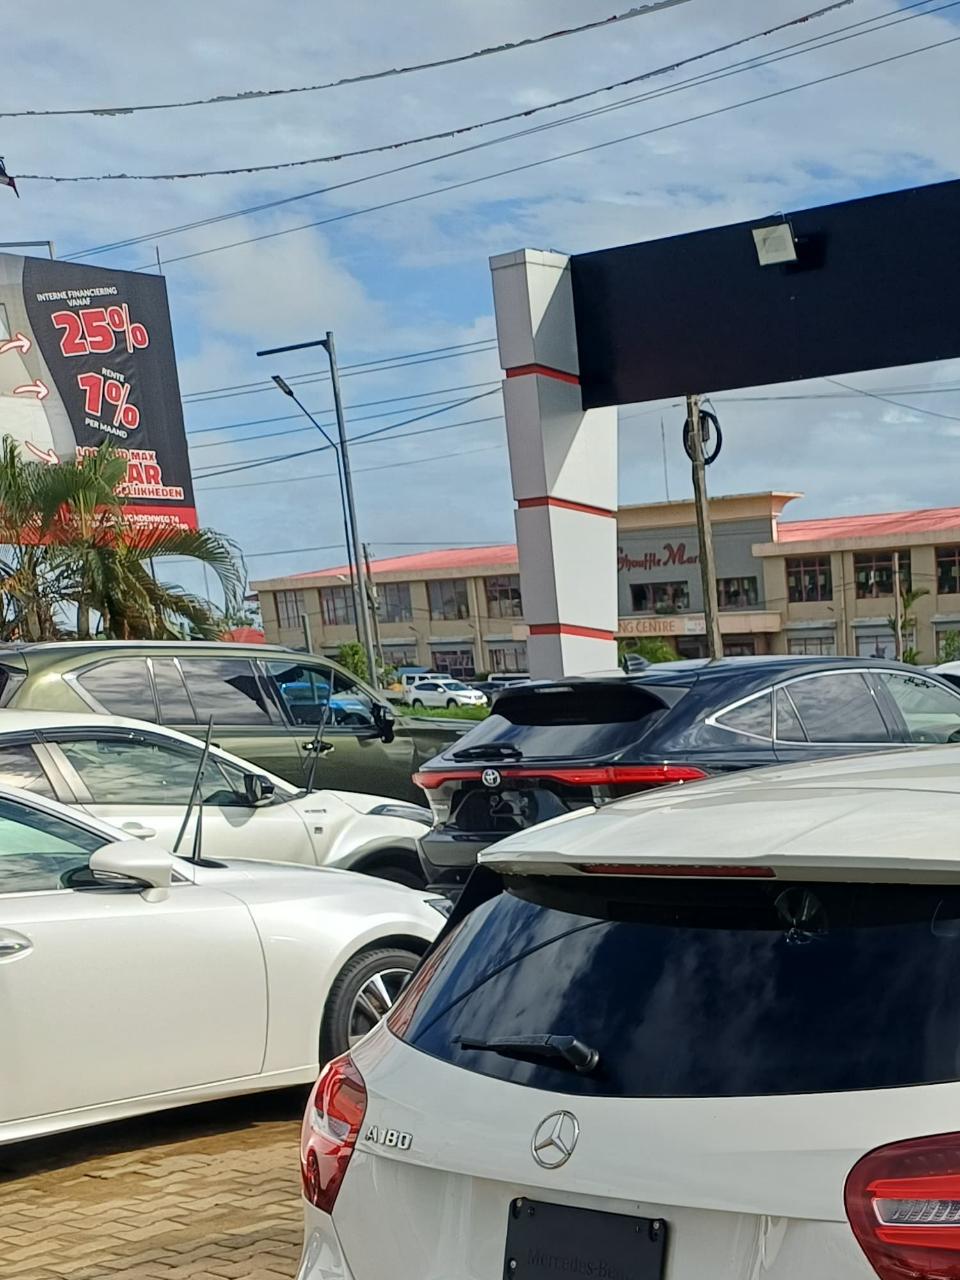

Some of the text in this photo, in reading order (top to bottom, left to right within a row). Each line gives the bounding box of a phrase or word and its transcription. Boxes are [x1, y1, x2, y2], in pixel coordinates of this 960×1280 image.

[36, 286, 118, 302] INTERNE FINANCIERING
[67, 297, 91, 307] VANAF
[51, 303, 149, 358] 25%
[101, 368, 125, 382] RENTE
[77, 371, 140, 430] 1%
[85, 417, 128, 439] PER MAAND
[129, 450, 156, 462] MAX
[663, 542, 701, 566] Mar
[618, 622, 634, 634] NG
[635, 620, 676, 633] CENTRE
